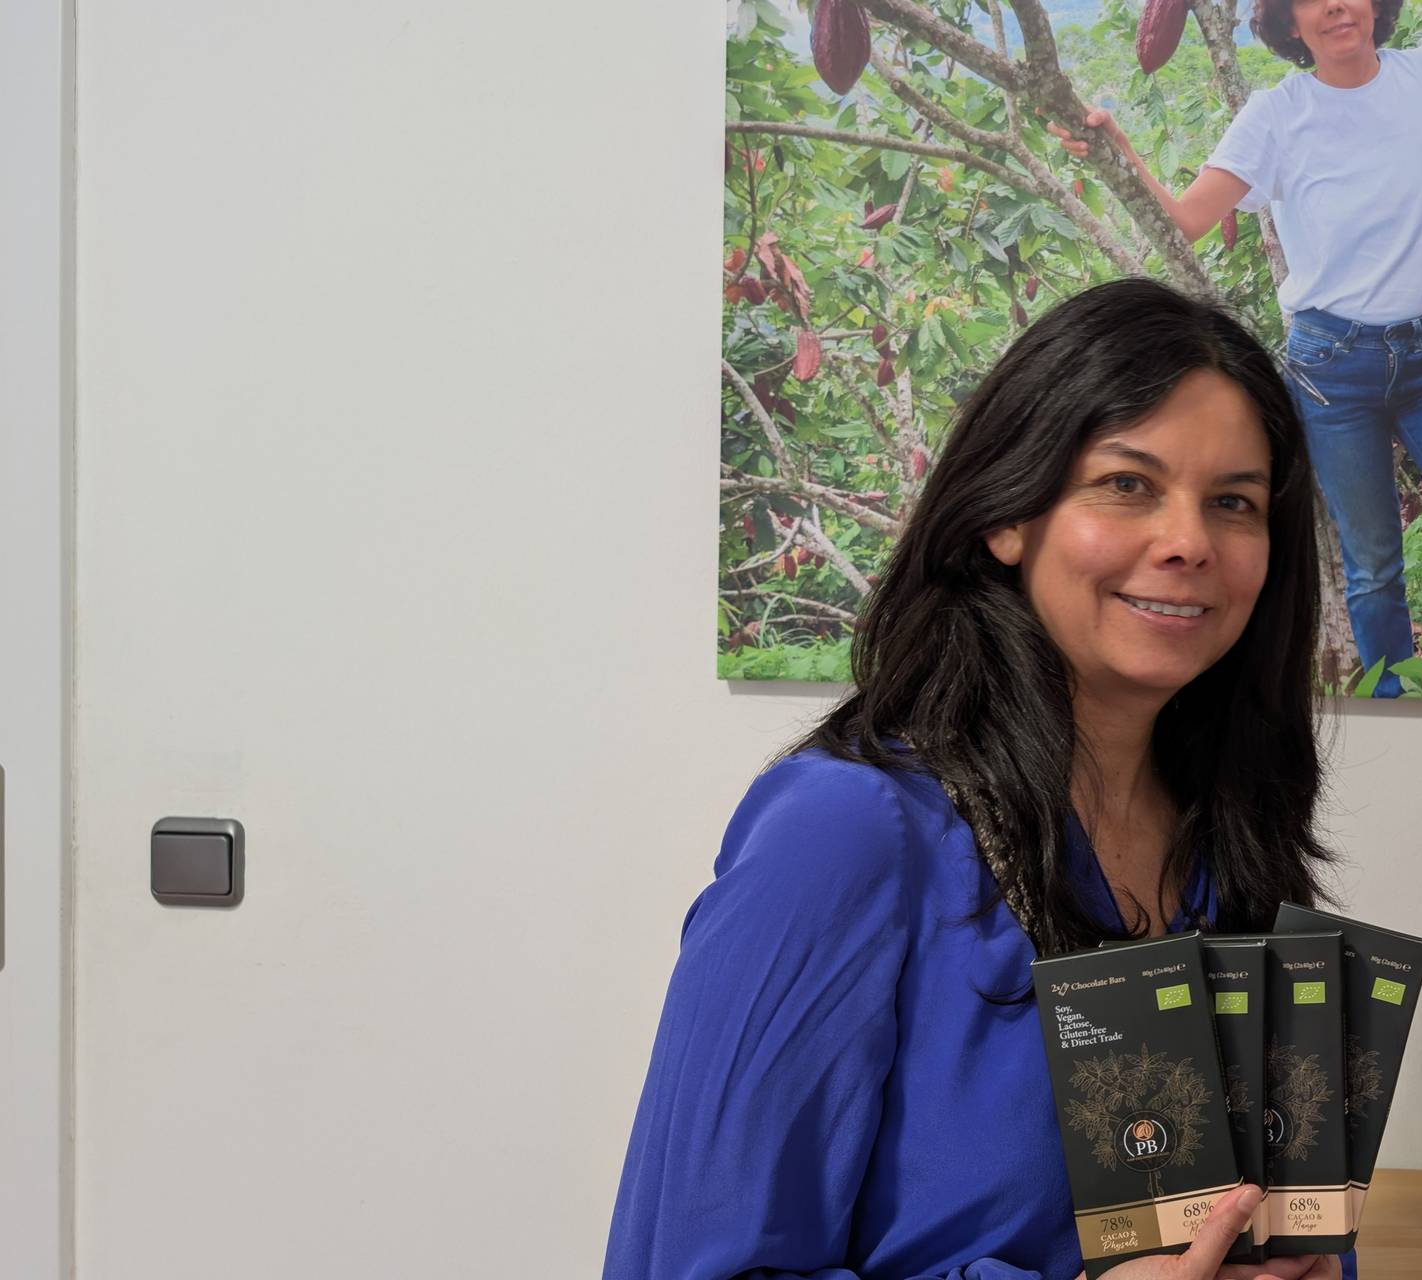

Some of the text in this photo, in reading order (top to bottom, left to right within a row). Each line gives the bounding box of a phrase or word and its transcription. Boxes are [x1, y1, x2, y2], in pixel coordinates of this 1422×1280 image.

[1071, 980, 1108, 991] Chocolate
[1109, 976, 1126, 985] Bars
[1060, 1026, 1107, 1040] Gluten-free
[1061, 1032, 1123, 1049] & Direct Trade
[1135, 1140, 1158, 1156] PB
[1183, 1201, 1215, 1218] 68%
[1289, 1198, 1320, 1211] 68%
[1100, 1216, 1133, 1233] 78%
[1100, 1231, 1129, 1242] CACAO
[1102, 1236, 1139, 1252] Physalis
